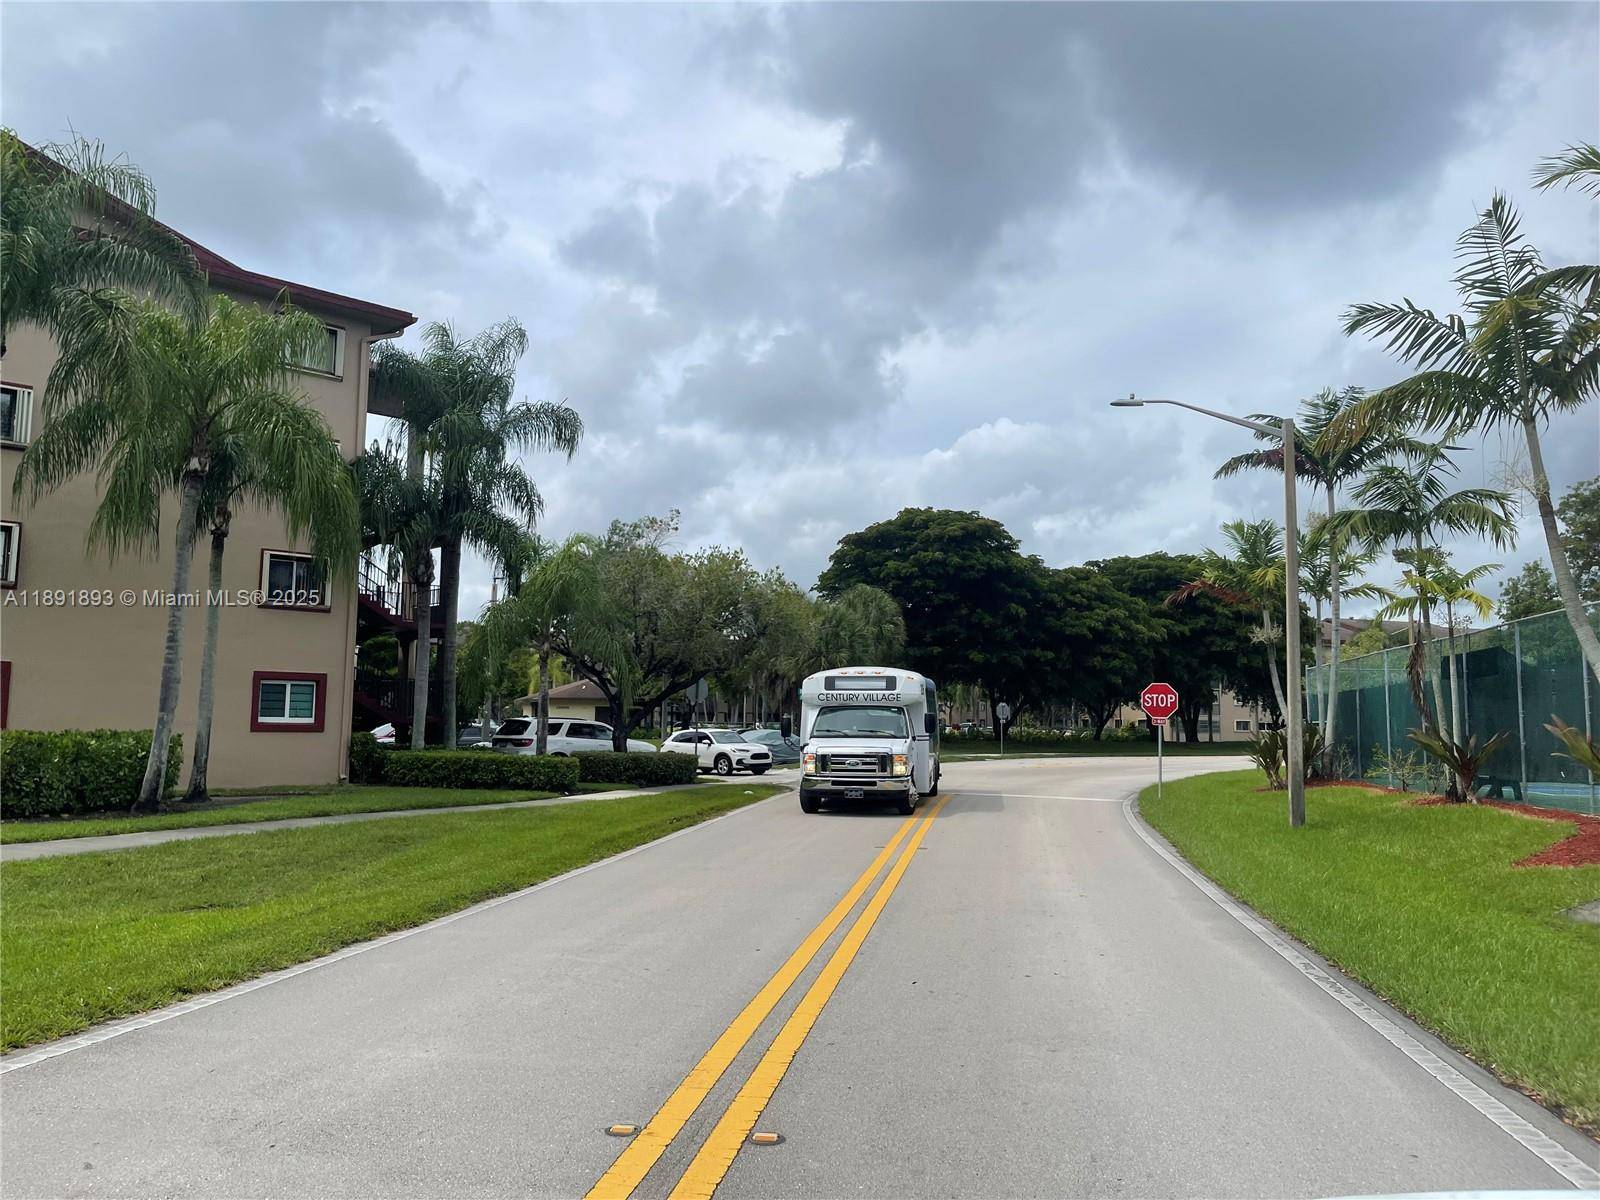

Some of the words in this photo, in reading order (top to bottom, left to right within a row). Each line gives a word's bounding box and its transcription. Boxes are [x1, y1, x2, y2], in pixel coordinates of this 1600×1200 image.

[817, 693, 860, 702] CENTURY
[862, 693, 901, 702] VILLAGE
[1144, 694, 1176, 707] STOP
